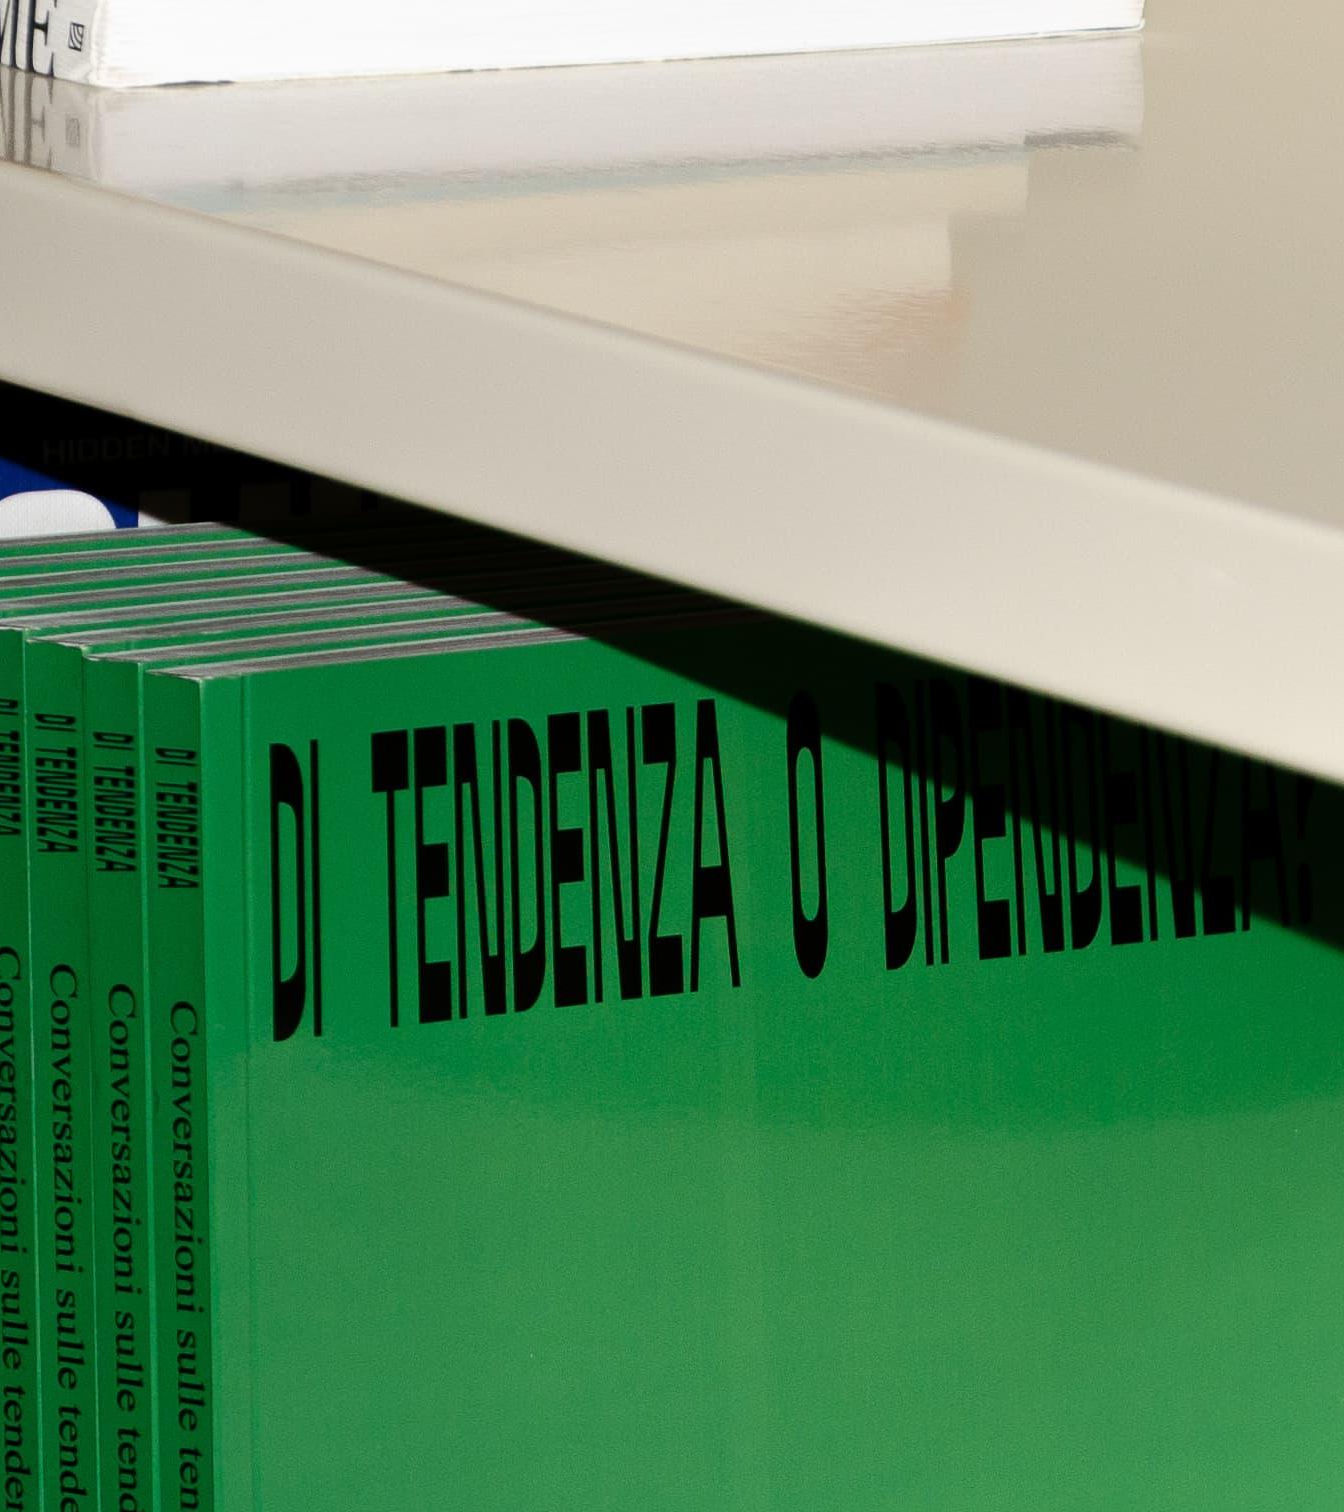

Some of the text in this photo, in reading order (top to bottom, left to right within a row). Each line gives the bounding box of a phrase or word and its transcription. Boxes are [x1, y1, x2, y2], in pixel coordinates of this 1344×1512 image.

[34, 713, 77, 733] DI
[92, 731, 135, 751] DI
[154, 747, 197, 767] DI
[35, 746, 79, 854] TENDENZA
[93, 765, 138, 874] TENDENZA
[155, 781, 200, 890] TENDENZA
[270, 740, 324, 1042] DI
[370, 697, 742, 1028] TENDENZA
[785, 688, 828, 981] O
[49, 963, 84, 1274] Conversazioni
[108, 983, 143, 1296] Conversazioni
[169, 1001, 205, 1314] Conversazioni
[1, 1268, 30, 1372] sulle
[57, 1288, 86, 1392] sulle
[114, 1308, 145, 1413] sulle
[176, 1327, 206, 1432] sulle
